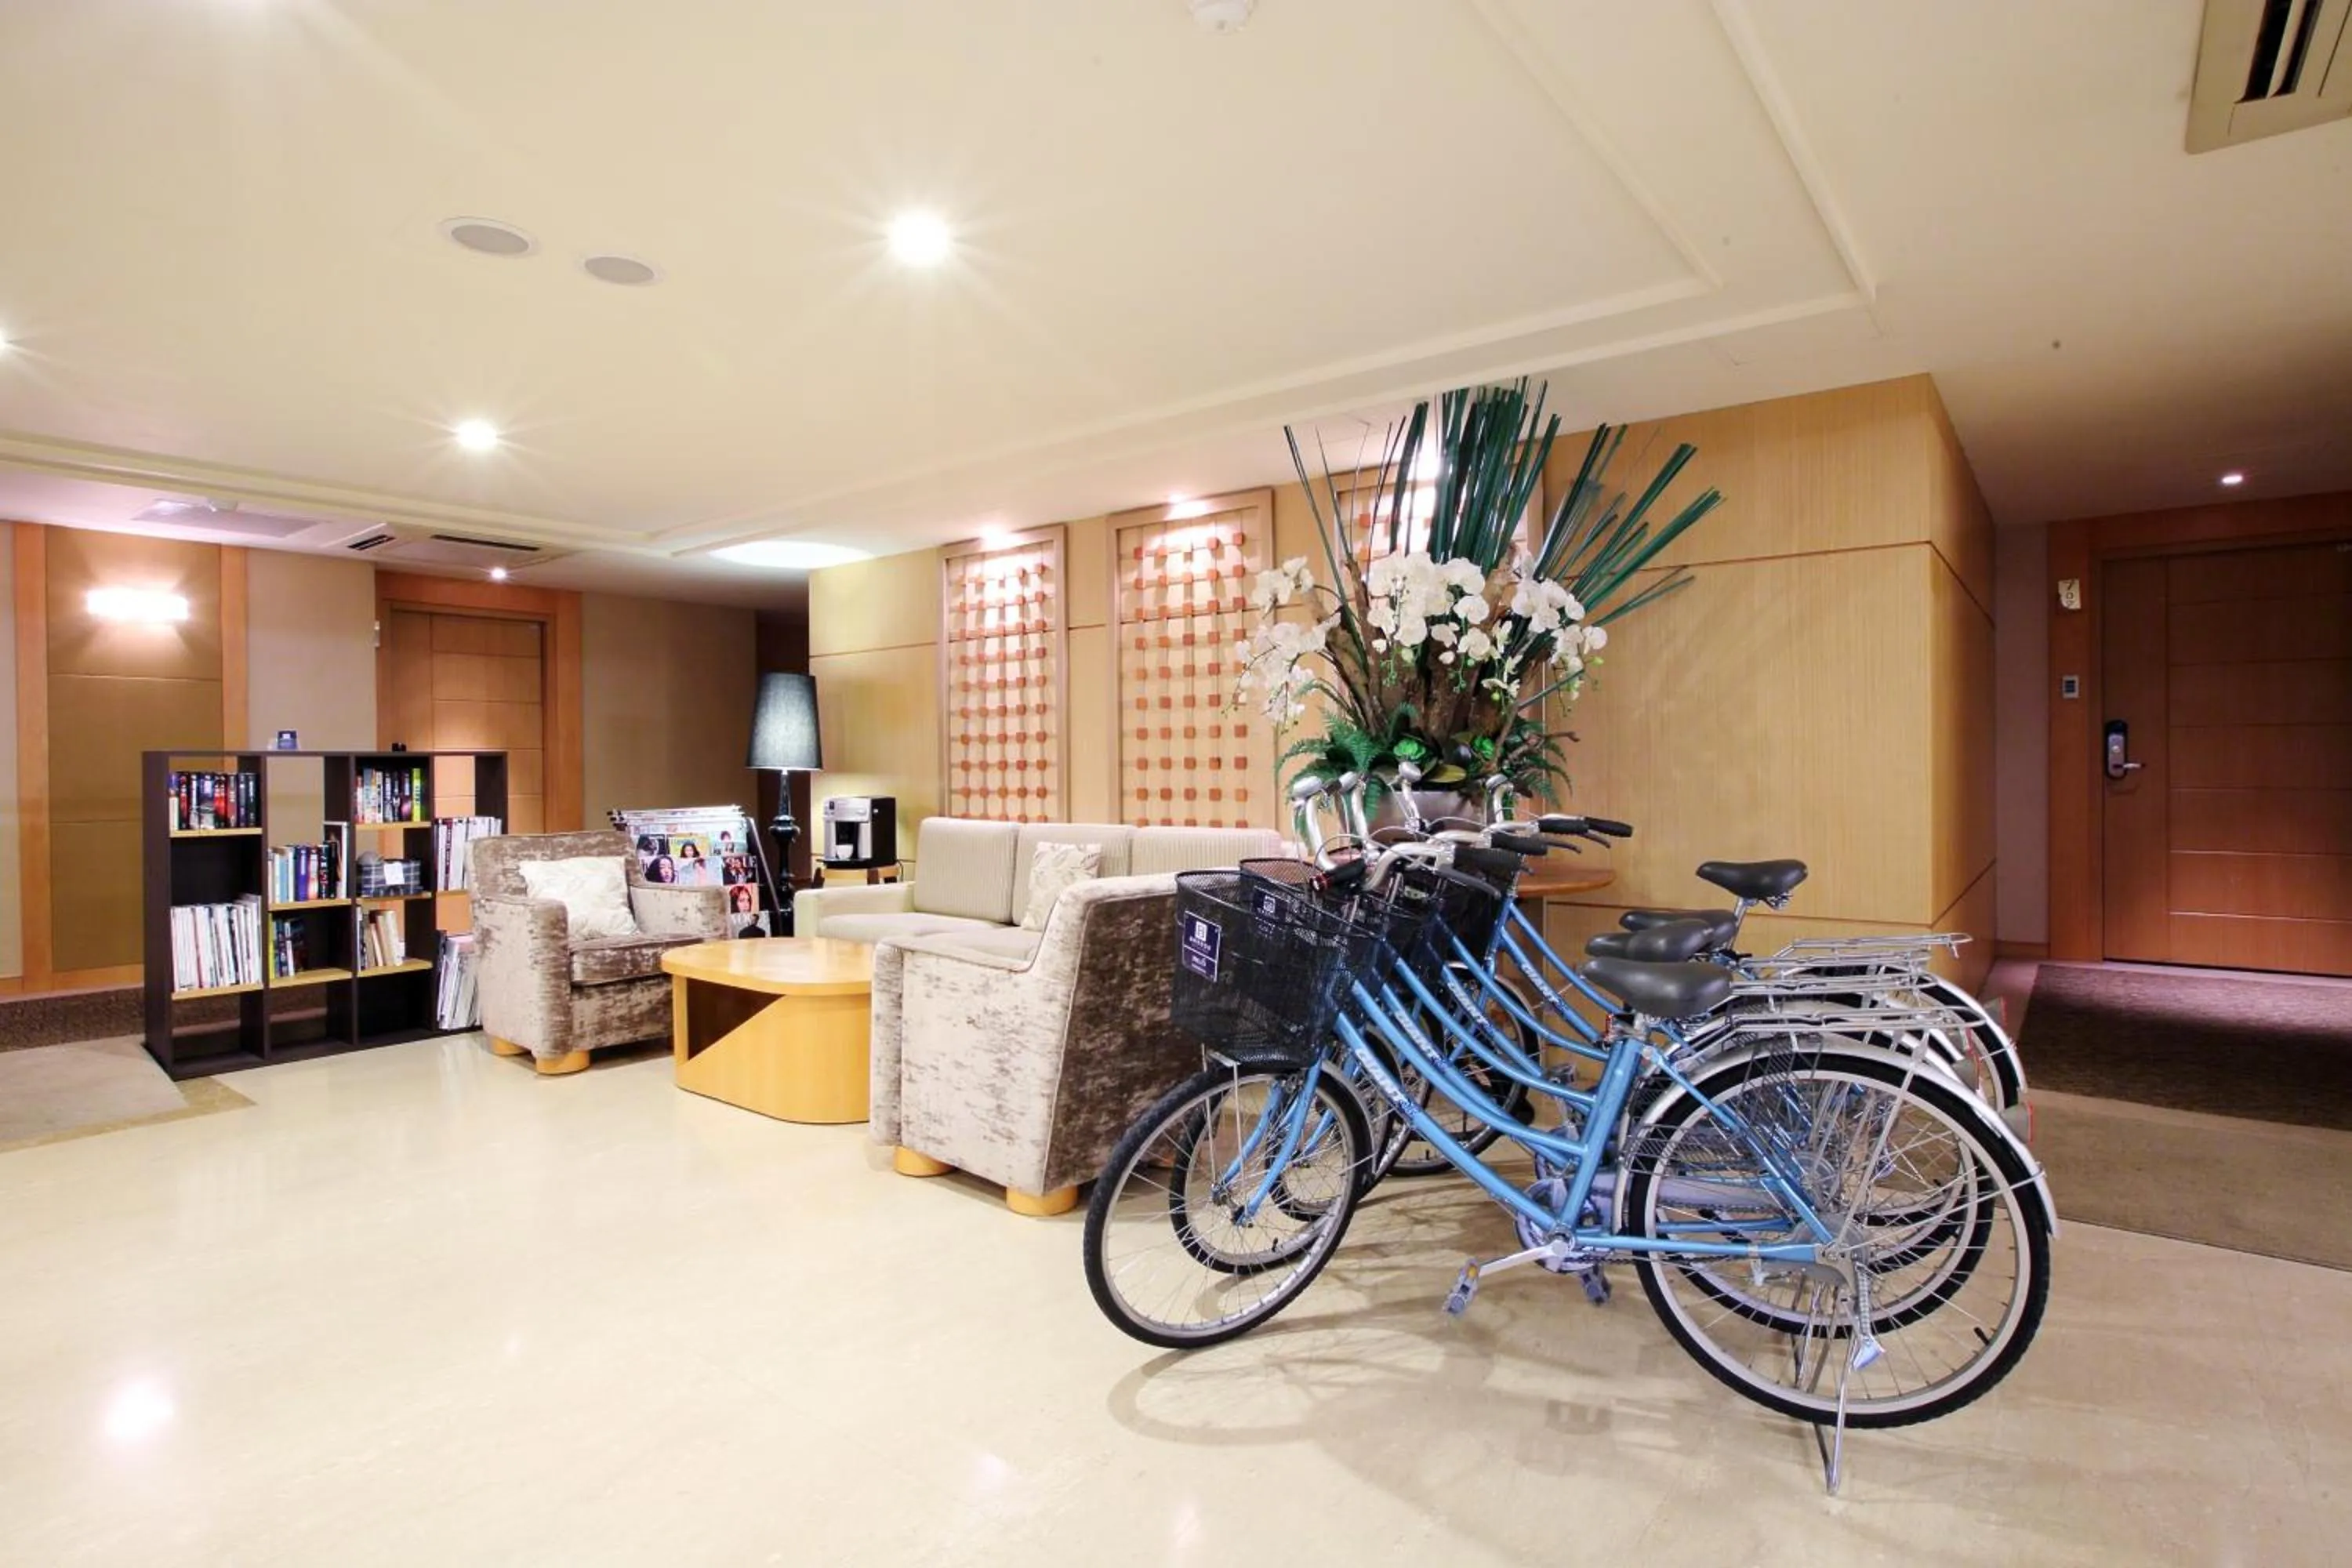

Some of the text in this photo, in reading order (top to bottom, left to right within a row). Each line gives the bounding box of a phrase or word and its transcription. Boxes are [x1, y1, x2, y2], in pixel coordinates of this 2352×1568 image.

[1446, 980, 1490, 1026] GIANT
[1394, 1009, 1442, 1062] GIANT
[1355, 1047, 1409, 1104] GIANT
